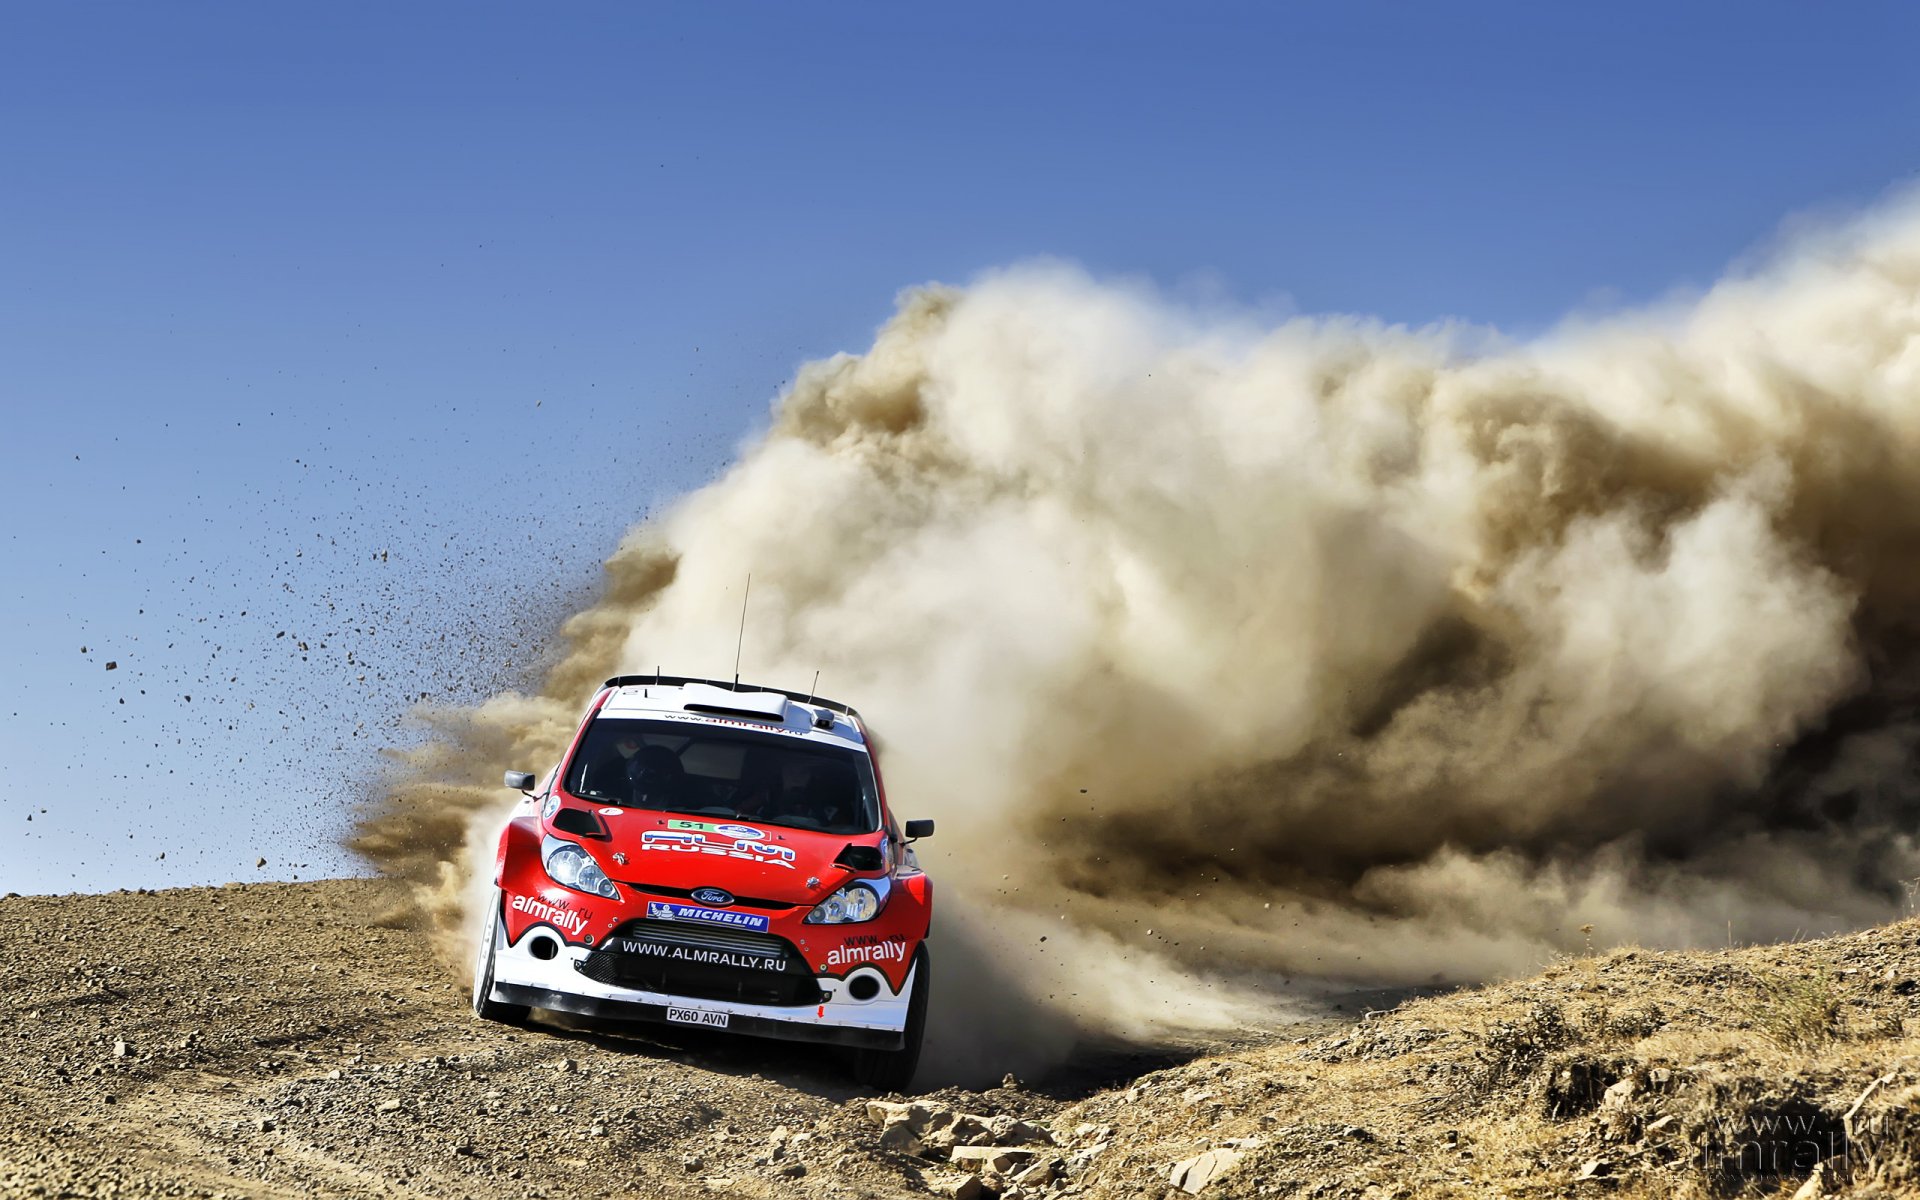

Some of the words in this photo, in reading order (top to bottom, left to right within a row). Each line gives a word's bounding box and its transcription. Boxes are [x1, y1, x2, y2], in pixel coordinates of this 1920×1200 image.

[664, 714, 803, 736] www.almrally.ru
[680, 821, 704, 830] 51
[641, 843, 796, 870] RUSSIA
[700, 890, 725, 903] Ford
[511, 895, 588, 936] almrally
[678, 907, 764, 927] MICHELIN
[622, 940, 786, 971] WWW.ALMRALLY.RU
[827, 940, 907, 965] almrally
[669, 1009, 699, 1022] PX60
[702, 1014, 727, 1026] AVN
